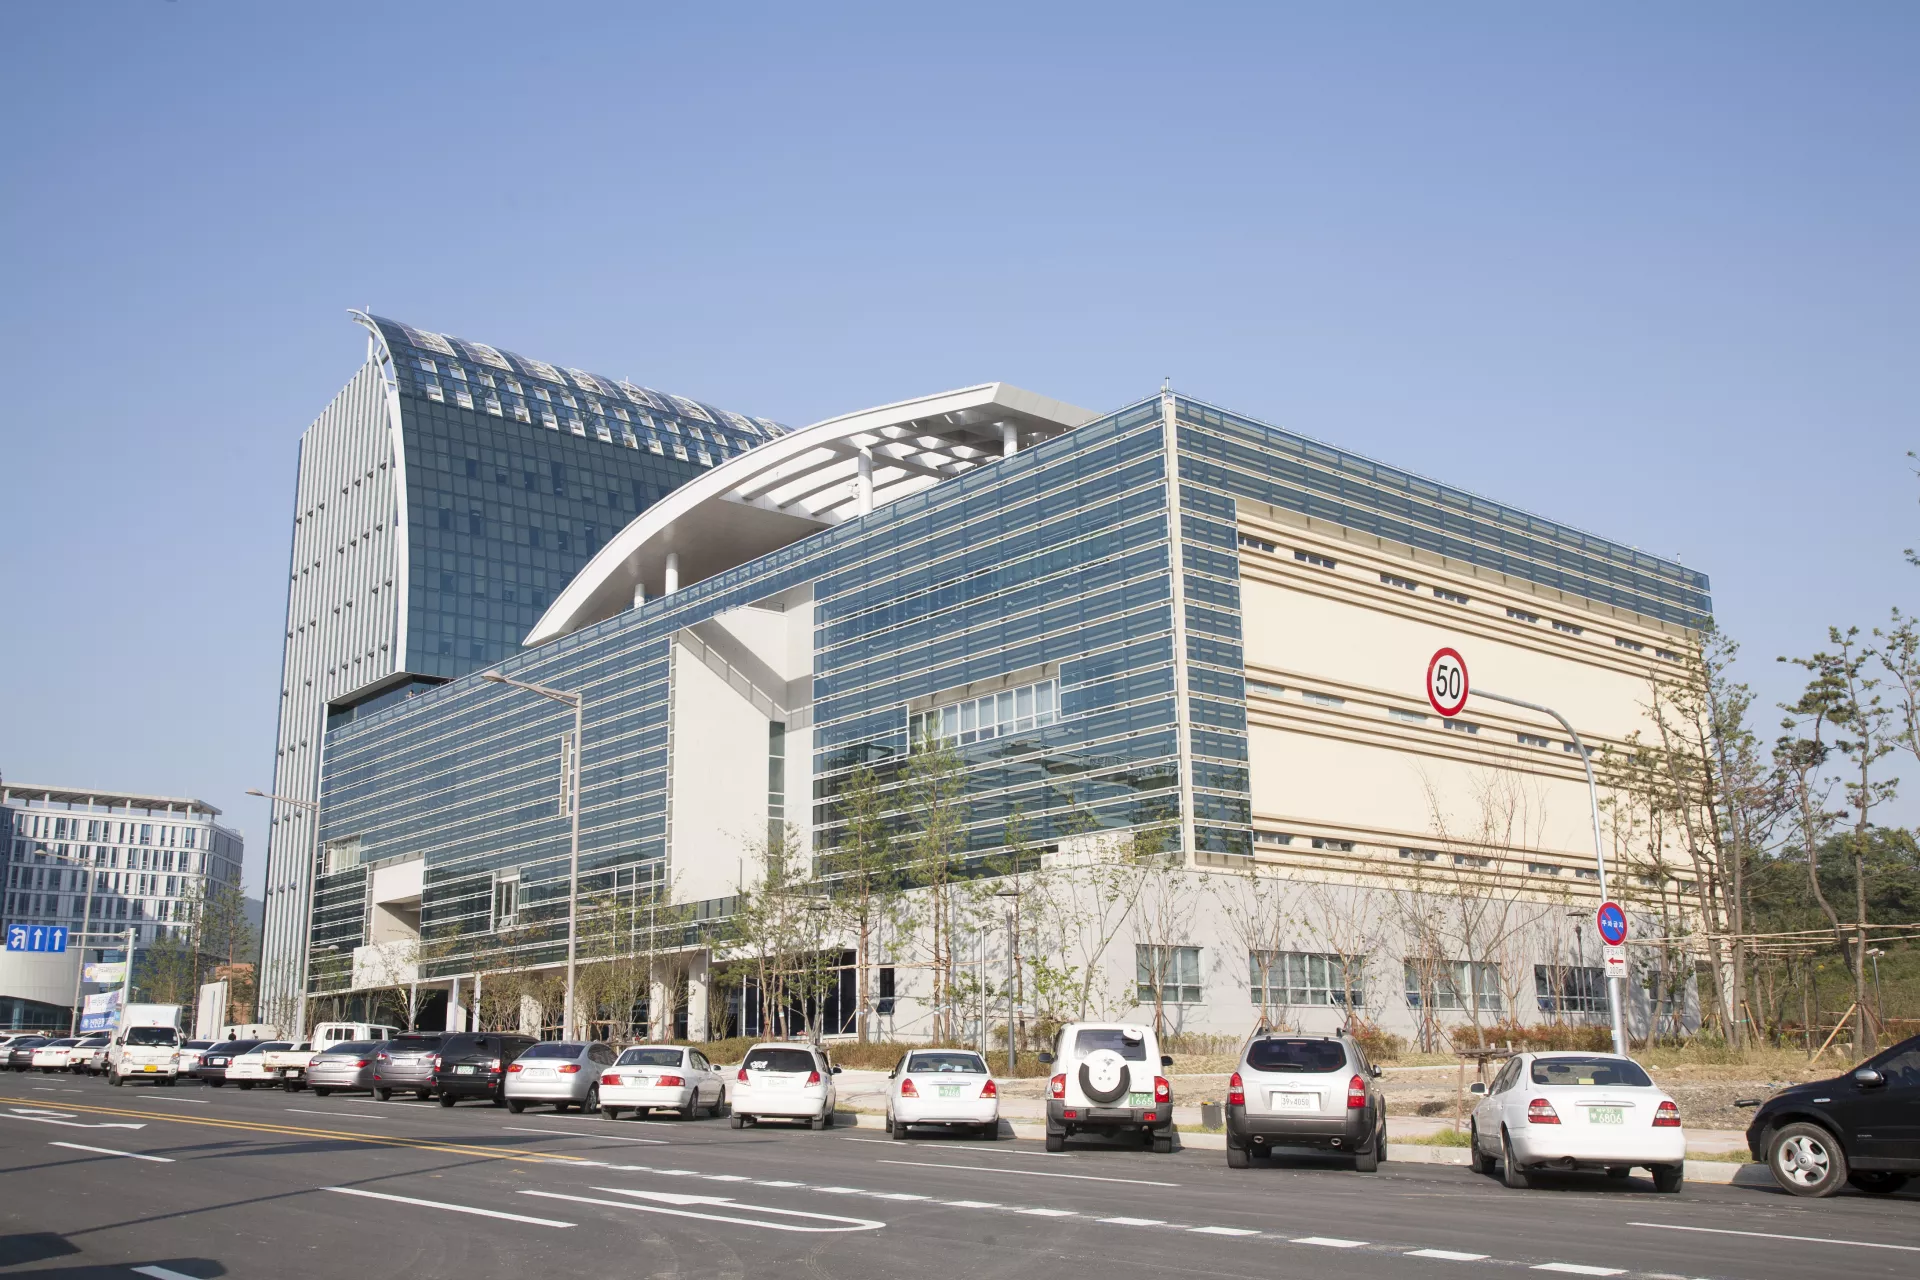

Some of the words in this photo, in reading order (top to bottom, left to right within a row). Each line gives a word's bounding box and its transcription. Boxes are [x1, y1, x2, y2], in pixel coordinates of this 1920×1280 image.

[1436, 664, 1460, 700] 50
[1602, 920, 1624, 929] 주차금지
[1130, 1097, 1153, 1106] 1665
[1599, 1113, 1622, 1124] 6806
